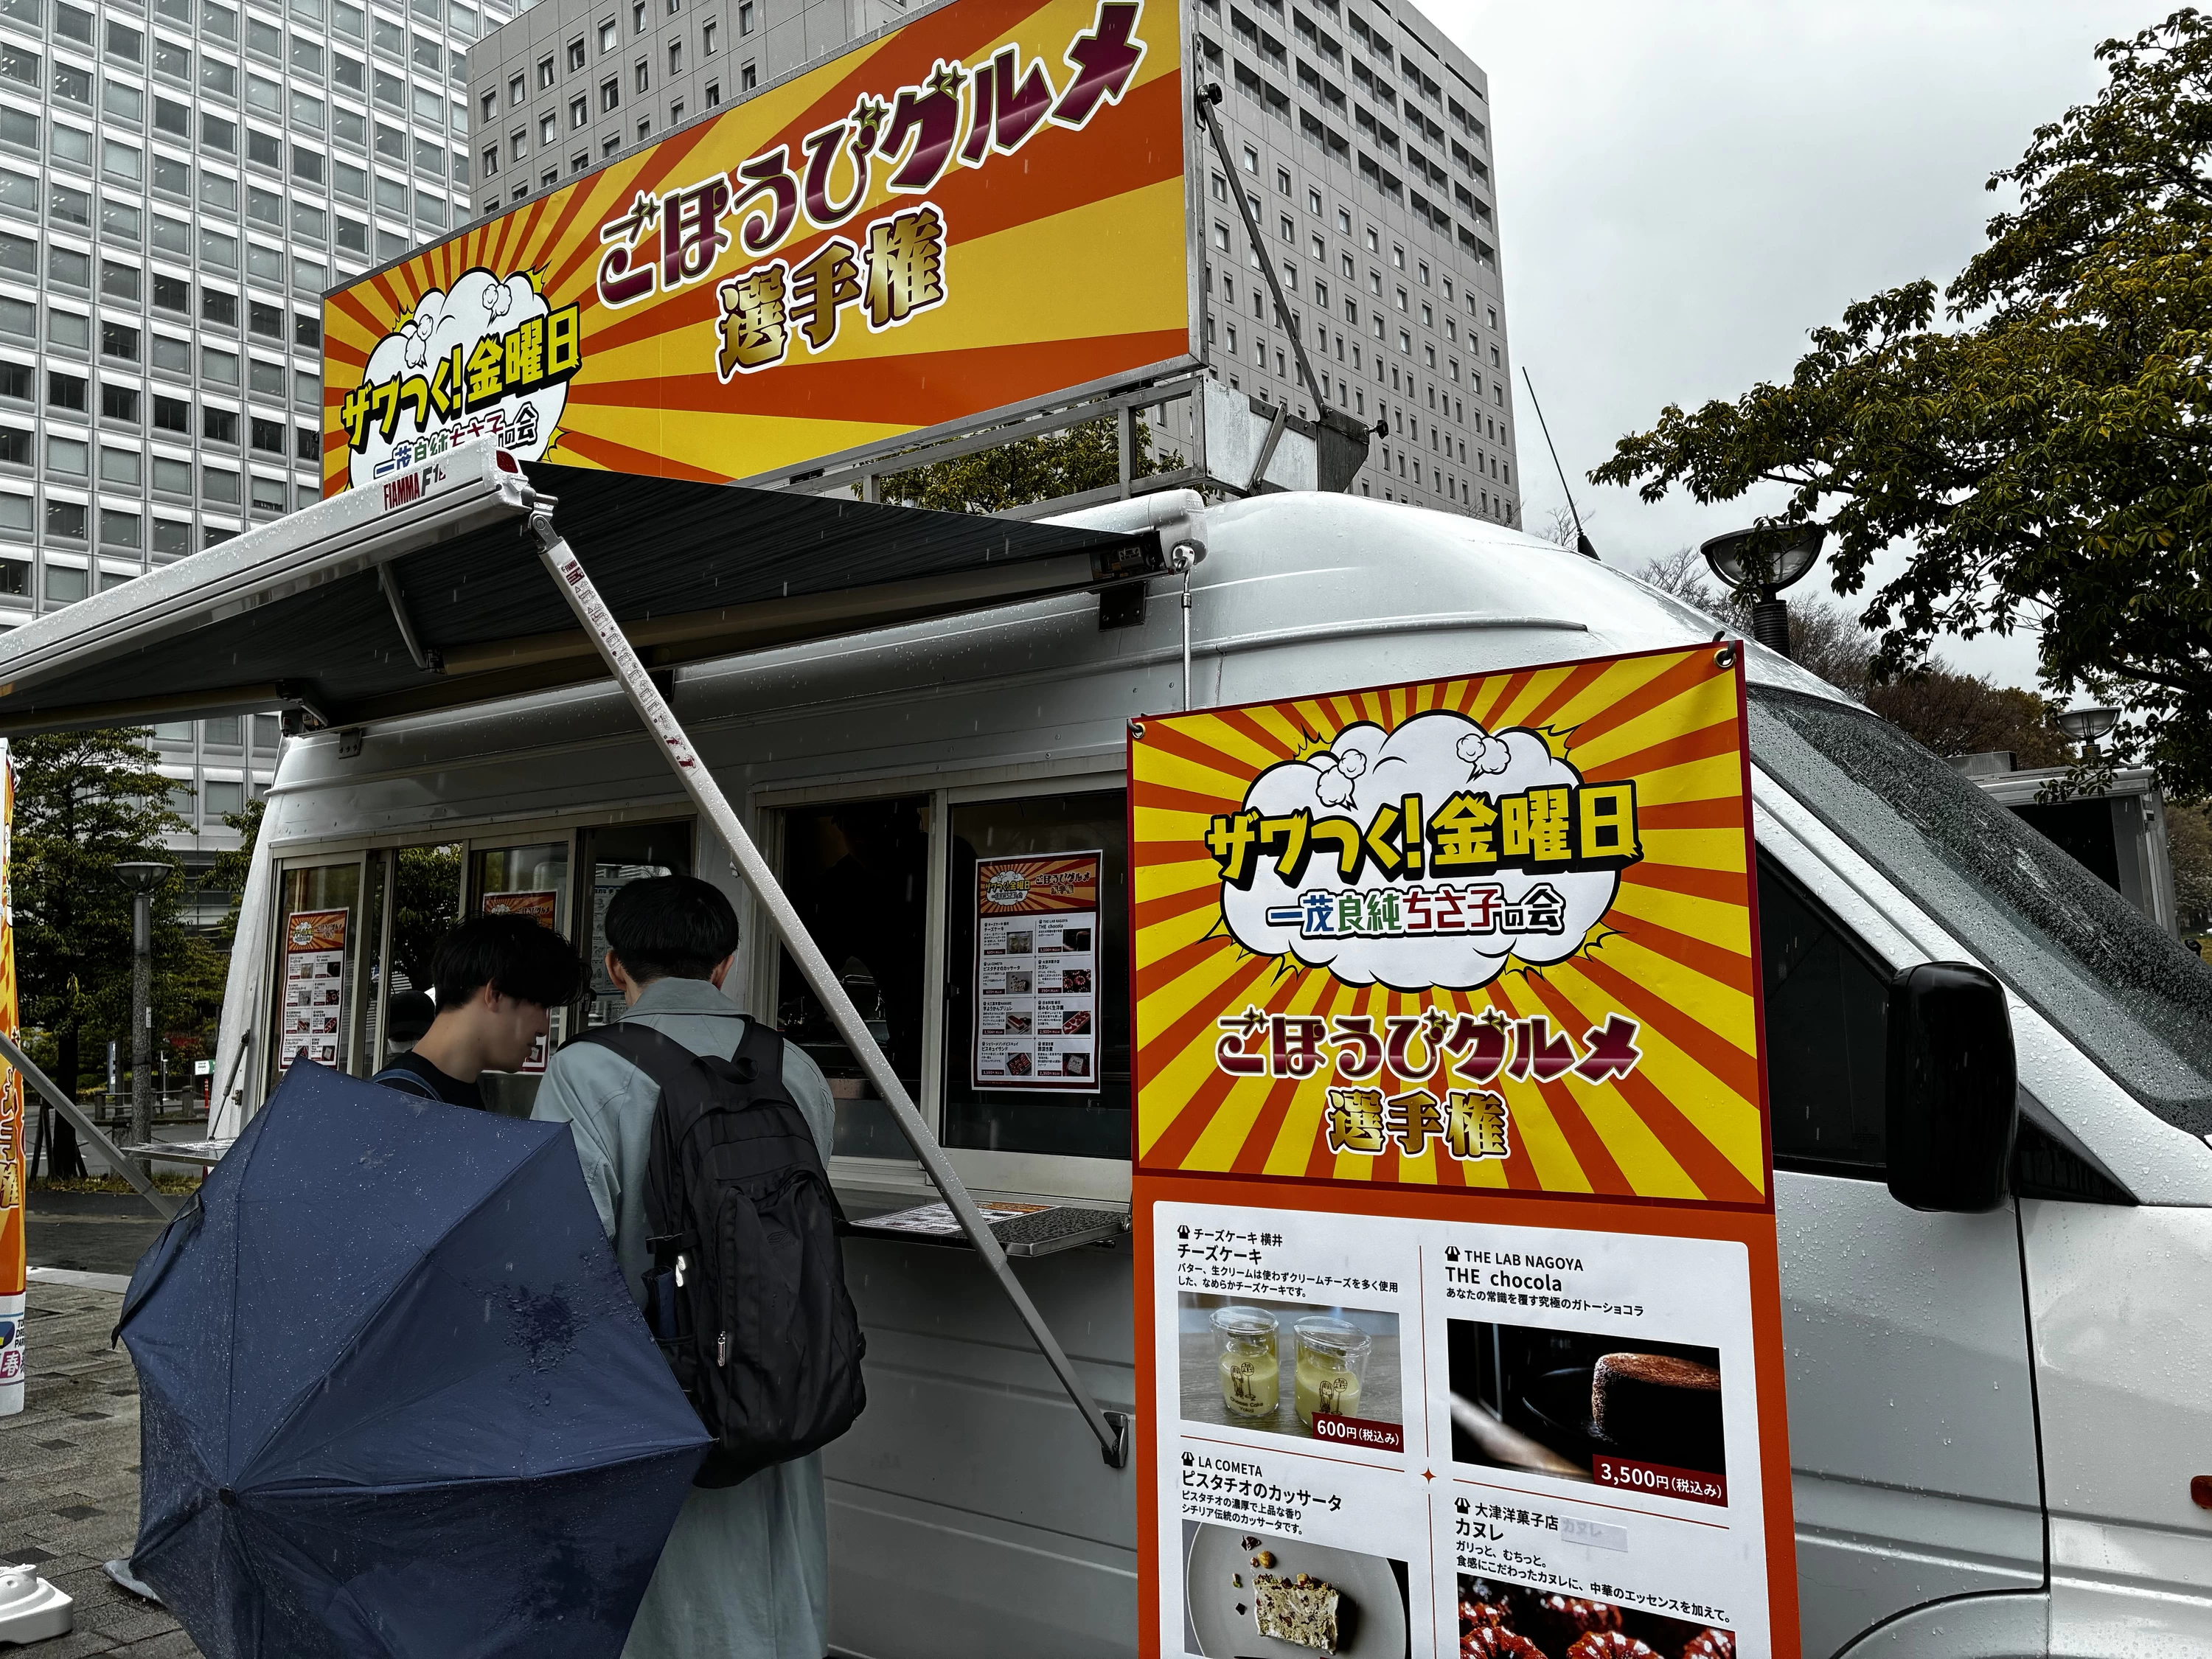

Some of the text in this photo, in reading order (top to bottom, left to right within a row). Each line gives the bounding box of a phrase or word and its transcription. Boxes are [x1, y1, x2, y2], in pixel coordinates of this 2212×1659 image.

[598, 1, 1144, 307] ごほうびグルメ
[717, 206, 946, 380] 選手権
[341, 303, 582, 452] ザワつく!金曜日
[383, 473, 420, 511] FIAMMA
[1206, 781, 1642, 886] ザワつく!金曜日
[1267, 884, 1564, 936] 一茂良純ちさ子の会
[1217, 1006, 1641, 1084] ごほうびグルメ
[1327, 1088, 1509, 1160] 選手権
[1194, 1228, 1283, 1247] チーズケーキ 横井
[1178, 1243, 1262, 1265] チーズケーキ
[1464, 1250, 1584, 1272] THE LAB NAGOYA
[1178, 1263, 1399, 1293] バター、生クリームは使わずクリームチーズを多く使用
[1178, 1276, 1307, 1298] した、なめらかチーズケーキです。
[1445, 1267, 1562, 1292] THE chocola
[1446, 1288, 1644, 1317] あなたの常識を覆す究極のガトーショコラ
[1317, 1419, 1399, 1446] 600円(税込み)
[1198, 1456, 1262, 1478] LA COMETA
[1601, 1463, 1722, 1499] 3,500円(税込み)
[1182, 1470, 1342, 1512] ピスタチオのカッサータ
[1182, 1490, 1301, 1520] ピスタチオの濃厚で上品な香り
[1182, 1504, 1303, 1535] シチリア伝統のカッサータです。
[1455, 1517, 1504, 1541] カヌレ
[1475, 1502, 1559, 1531] 大津洋菓子店
[1456, 1555, 1731, 1624] 食感にこだわったカヌレに、中華のエッセンスを加えて。
